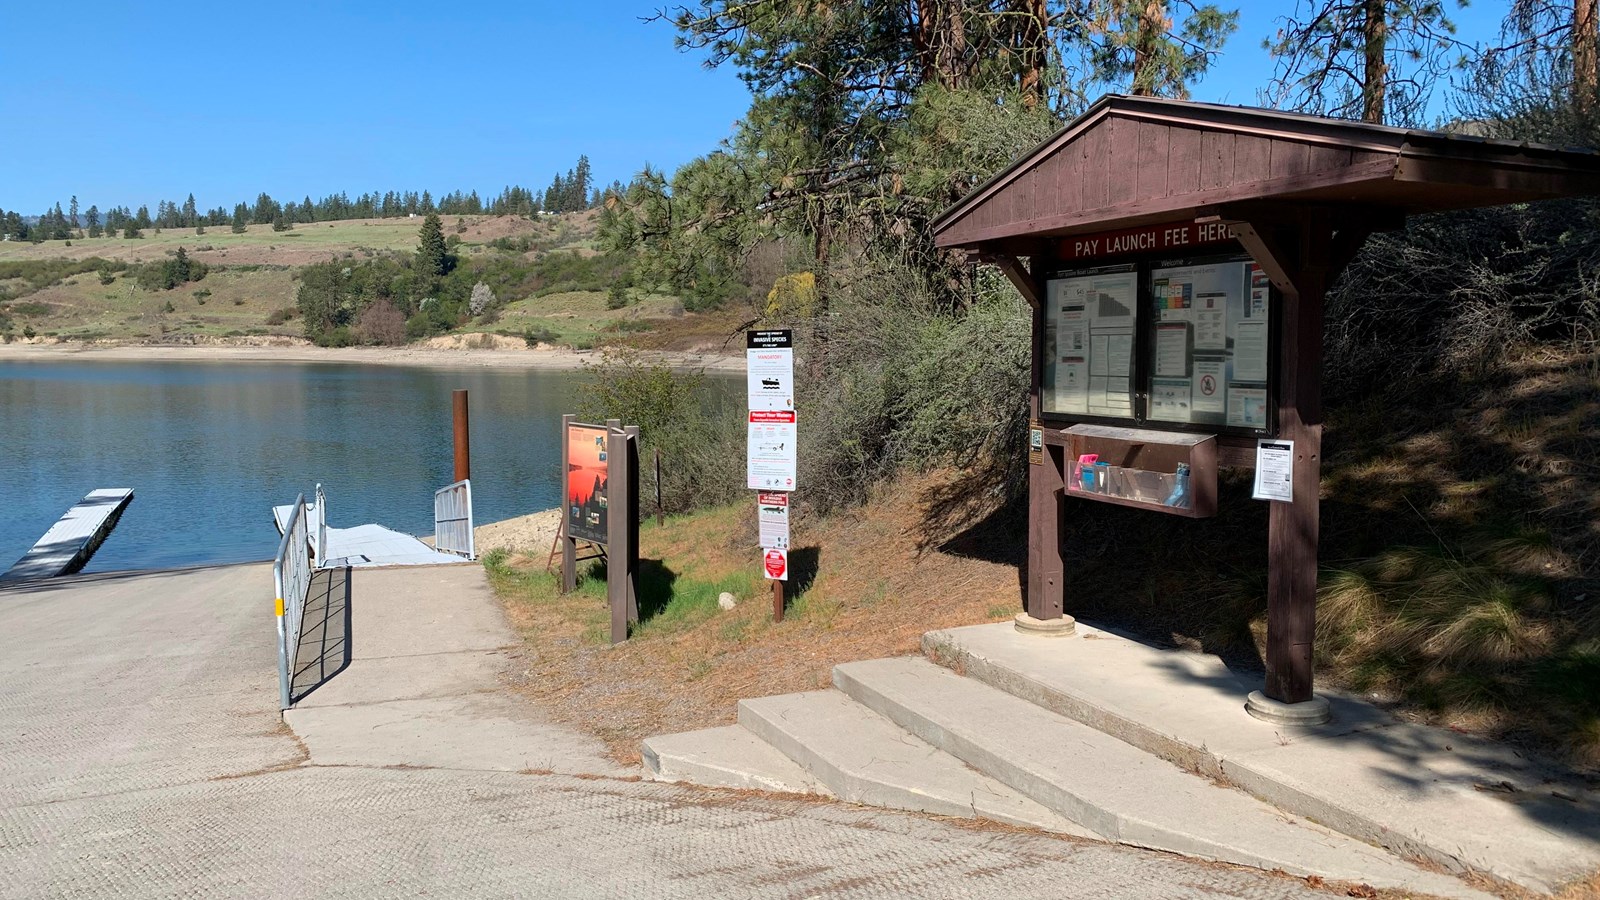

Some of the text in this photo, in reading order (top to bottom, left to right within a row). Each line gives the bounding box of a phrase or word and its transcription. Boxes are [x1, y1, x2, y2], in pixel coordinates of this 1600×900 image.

[1075, 240, 1099, 256] PAY
[1106, 232, 1156, 254] LAUNCH
[1164, 227, 1189, 246] FEE
